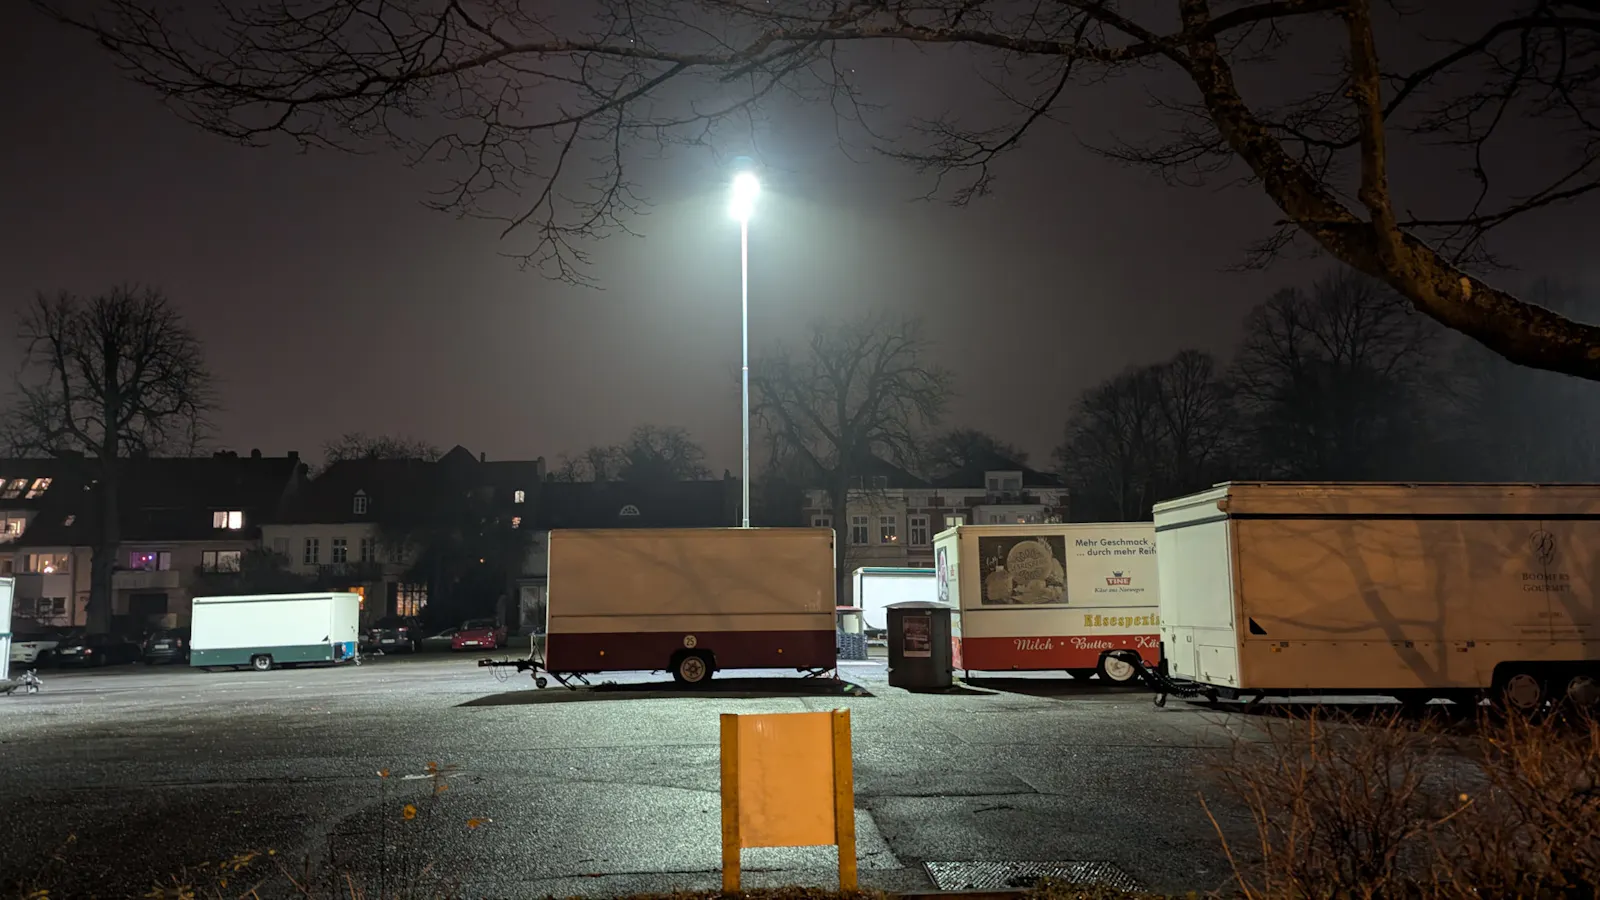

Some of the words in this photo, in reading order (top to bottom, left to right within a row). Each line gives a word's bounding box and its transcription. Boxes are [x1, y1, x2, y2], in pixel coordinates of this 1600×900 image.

[1075, 539, 1098, 547] Mehr
[1100, 538, 1149, 546] Geschmack
[1087, 548, 1111, 556] durch
[1113, 547, 1136, 555] mehr
[686, 637, 695, 646] 25
[1013, 638, 1054, 651] Milch
[1070, 637, 1115, 650] Butter
